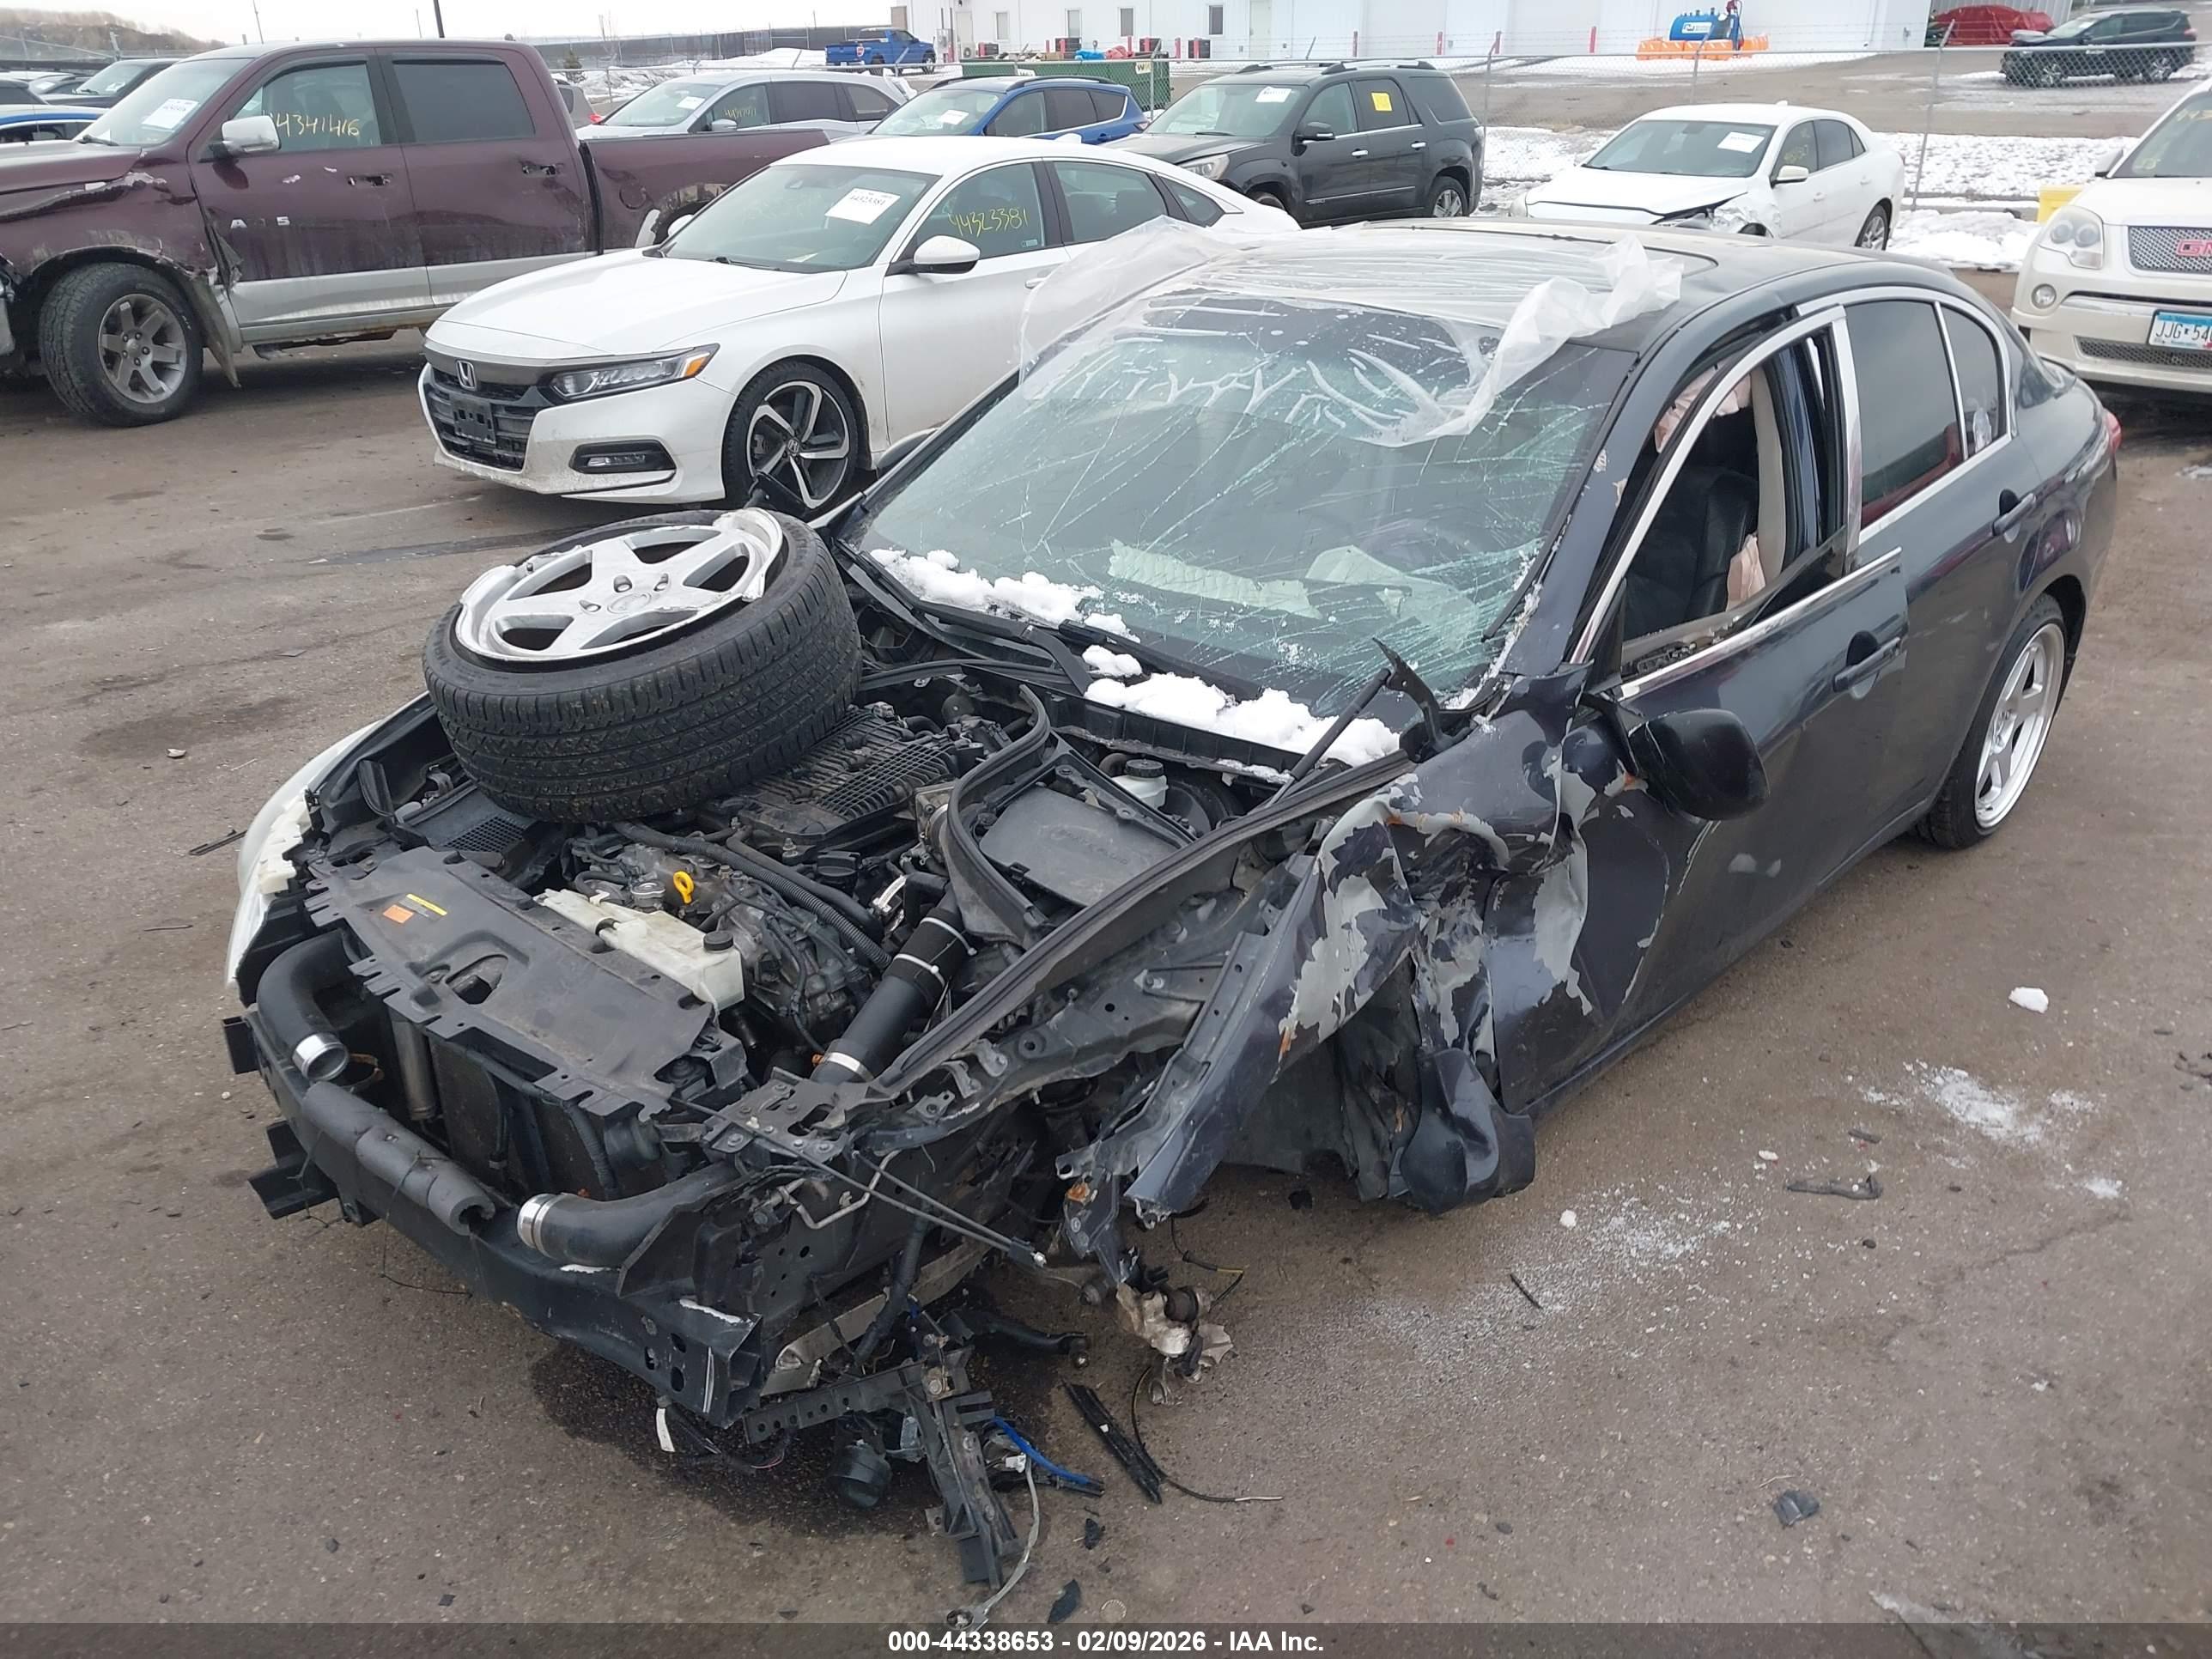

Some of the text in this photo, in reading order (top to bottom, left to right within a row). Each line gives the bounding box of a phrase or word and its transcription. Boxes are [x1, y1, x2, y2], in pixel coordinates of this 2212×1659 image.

[263, 110, 360, 137] 4341416
[947, 206, 1028, 237] 44323381
[2155, 321, 2183, 338] JJG
